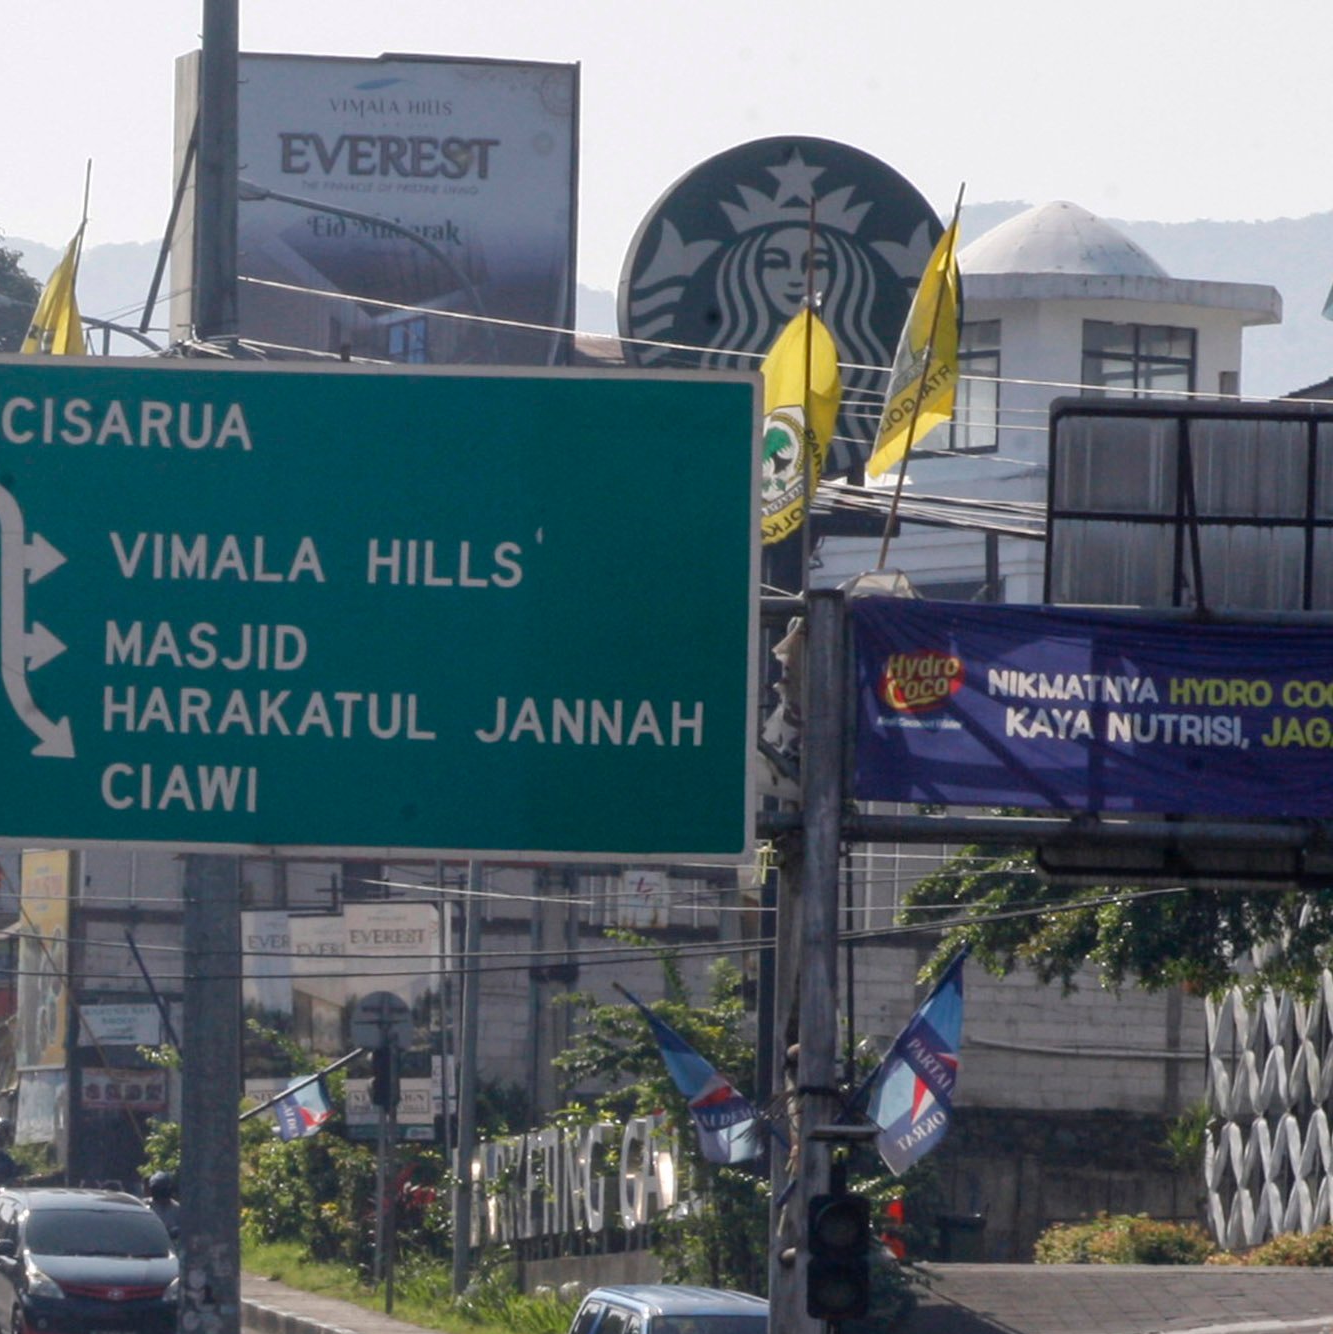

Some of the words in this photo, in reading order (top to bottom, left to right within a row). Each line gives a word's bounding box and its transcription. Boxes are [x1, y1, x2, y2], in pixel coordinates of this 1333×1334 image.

[329, 98, 400, 118] VIMALA
[407, 98, 453, 116] HILLS
[278, 132, 501, 180] EVEREST
[2, 397, 252, 451] CISARUA
[110, 532, 325, 585] VIMALA
[368, 540, 524, 589] HILLS
[104, 621, 308, 672] MASJID
[887, 653, 960, 680] Hydro
[988, 668, 1160, 704] NIKMATNYA
[1169, 679, 1273, 708] HYDRO
[103, 686, 436, 743] HARAKATUL
[476, 697, 704, 749] JANNAH
[1005, 706, 1095, 741] KAYA
[1107, 711, 1249, 750] NUTRISI,
[1261, 716, 1333, 748] JAG
[101, 763, 258, 815] CIAWI
[350, 928, 426, 946] EVEREST
[906, 1037, 953, 1089] PARTAI
